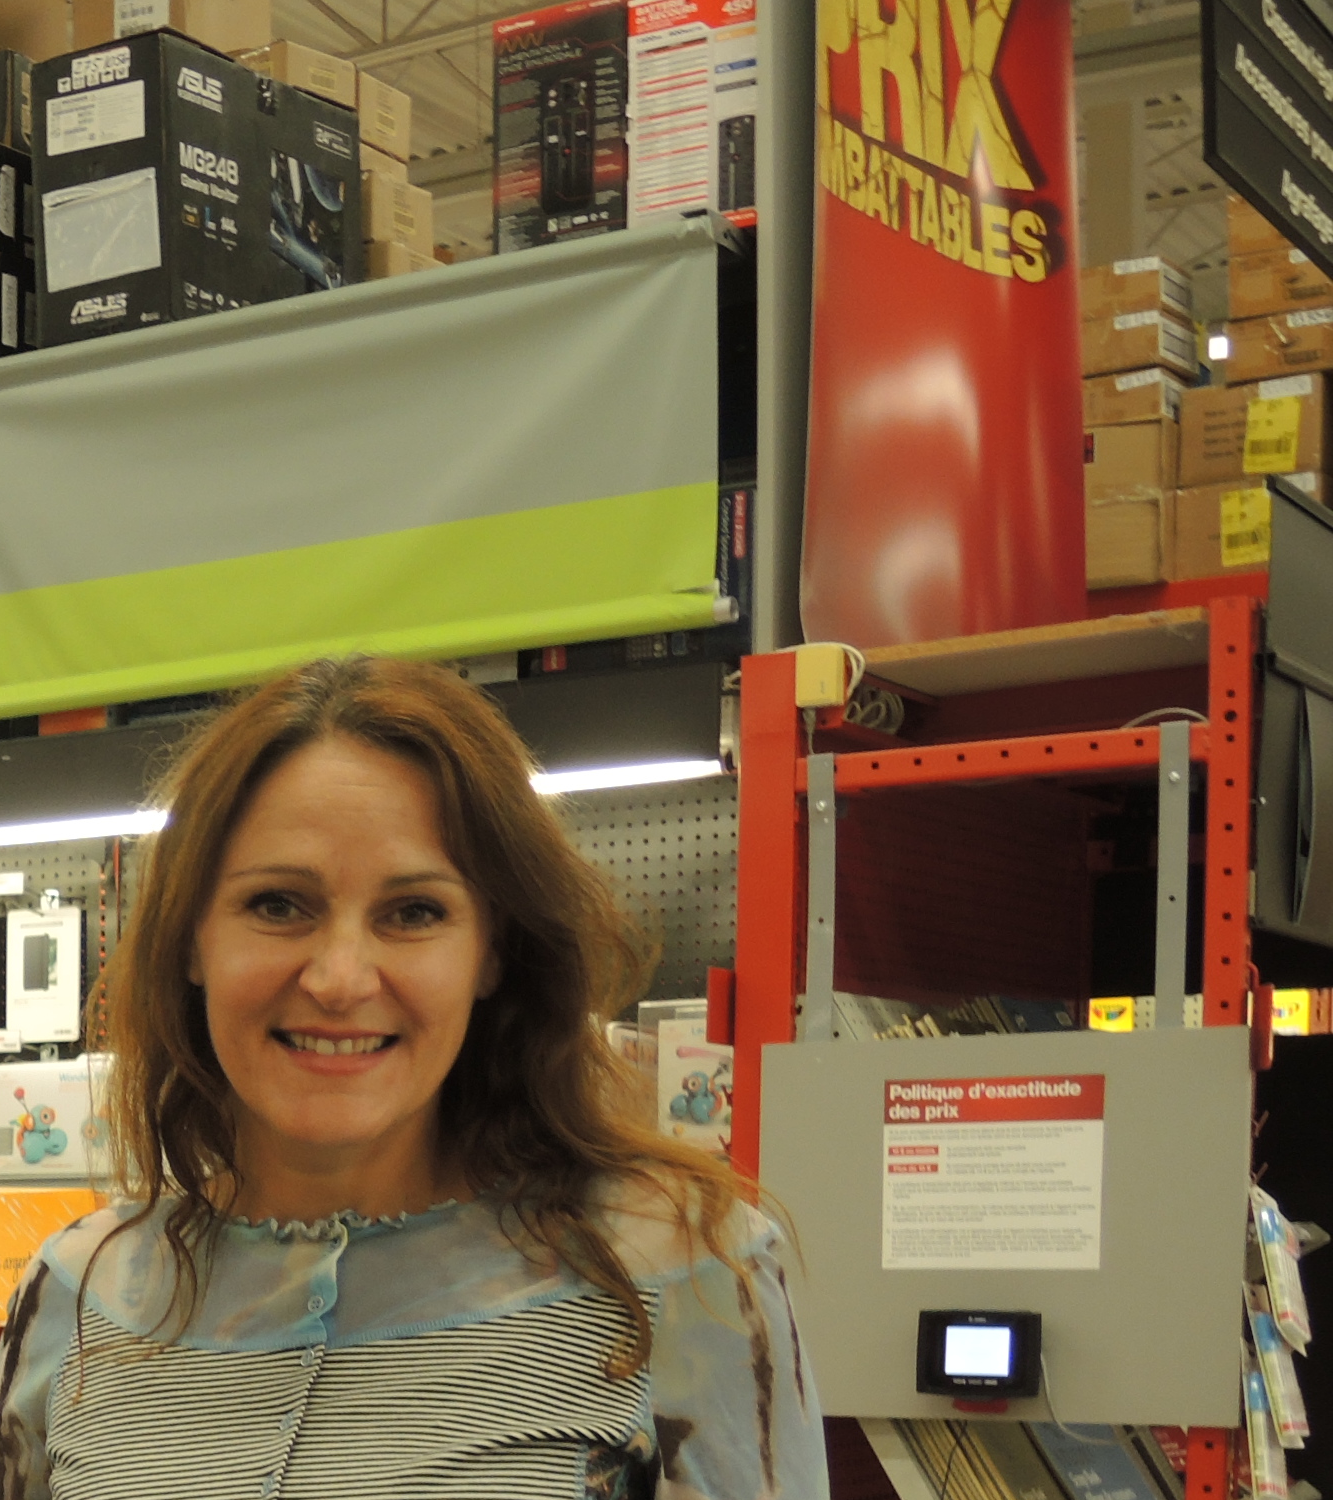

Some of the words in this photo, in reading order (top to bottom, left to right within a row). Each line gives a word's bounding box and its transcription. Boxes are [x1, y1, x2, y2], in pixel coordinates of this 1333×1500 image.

[177, 66, 224, 101] ASUS
[815, 0, 1036, 192] PRIX
[179, 141, 239, 186] MG248
[888, 1083, 965, 1103] Politique
[967, 1079, 1083, 1100] d'exactitude
[888, 1104, 921, 1121] des
[924, 1102, 960, 1122] prix
